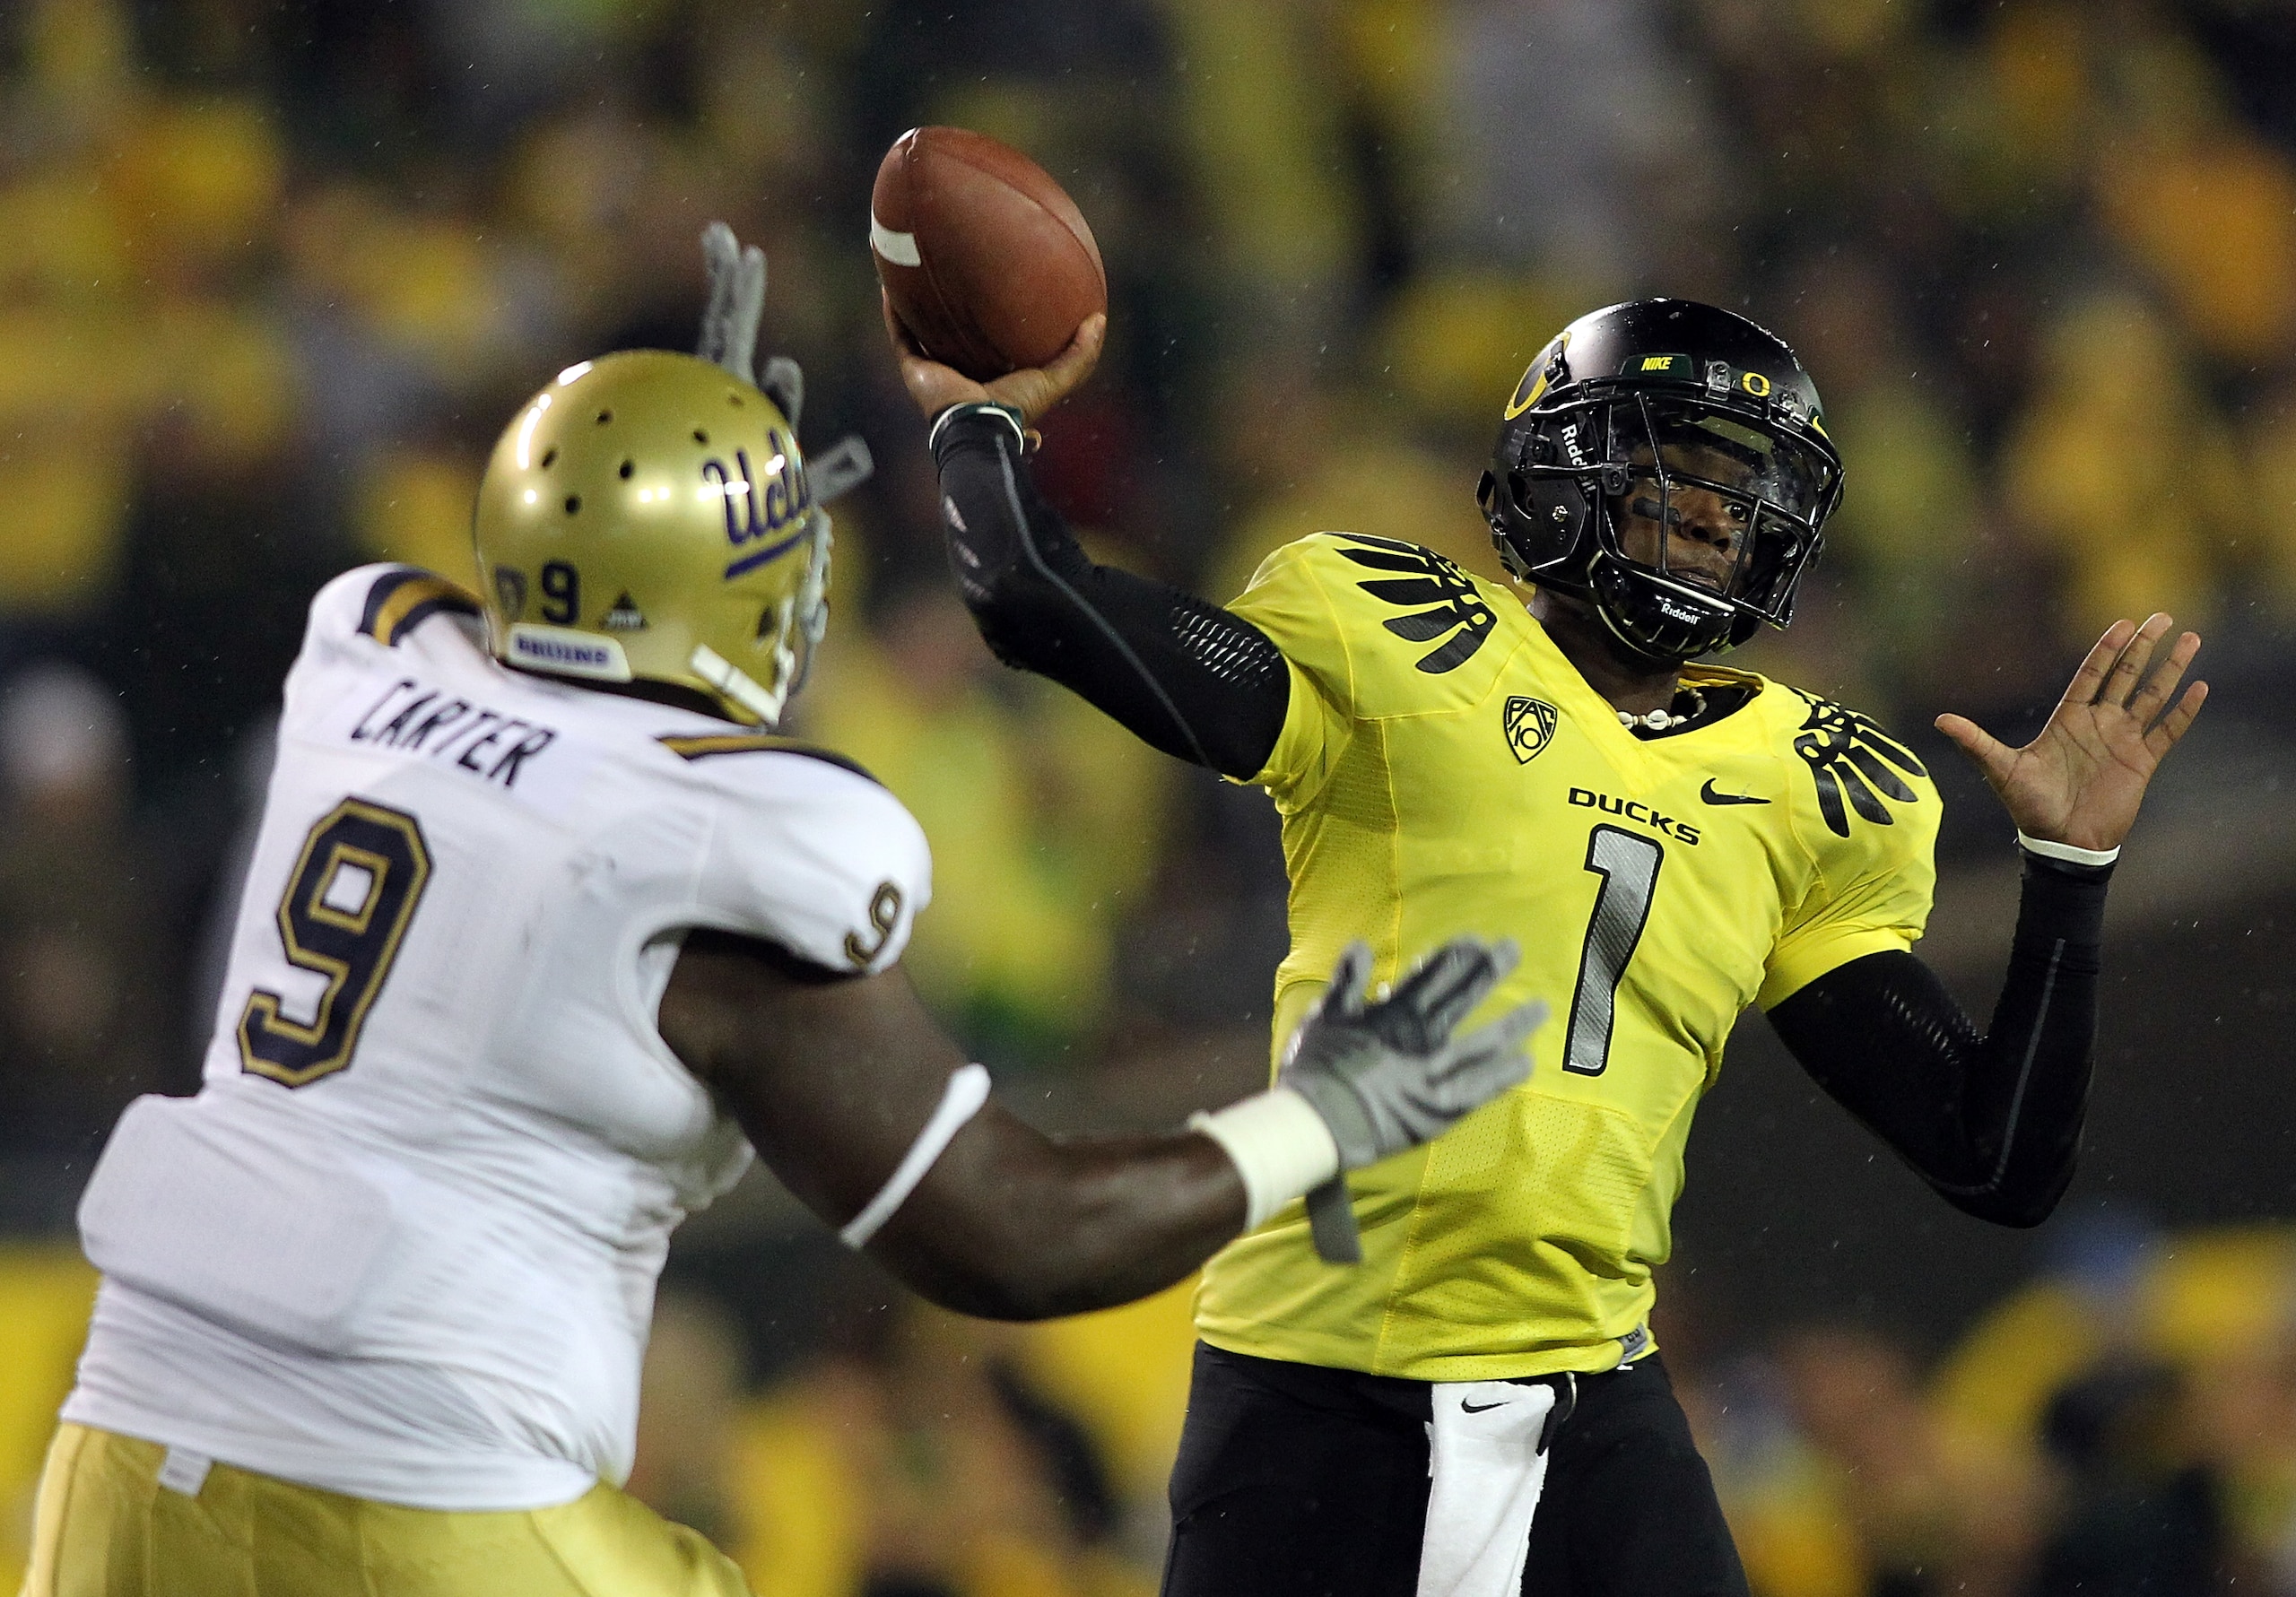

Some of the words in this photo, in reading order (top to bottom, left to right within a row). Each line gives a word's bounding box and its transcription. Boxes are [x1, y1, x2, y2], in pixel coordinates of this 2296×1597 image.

[1641, 356, 1673, 370] NIKE
[541, 560, 578, 626] 9
[1660, 603, 1699, 625] Riddell
[352, 681, 557, 786] CARTER
[1508, 699, 1555, 741] PAC
[1514, 725, 1543, 750] 10
[1568, 787, 1700, 846] DUCKS
[237, 796, 432, 1088] 9
[844, 881, 900, 966] 9
[1562, 823, 1664, 1077] 1
